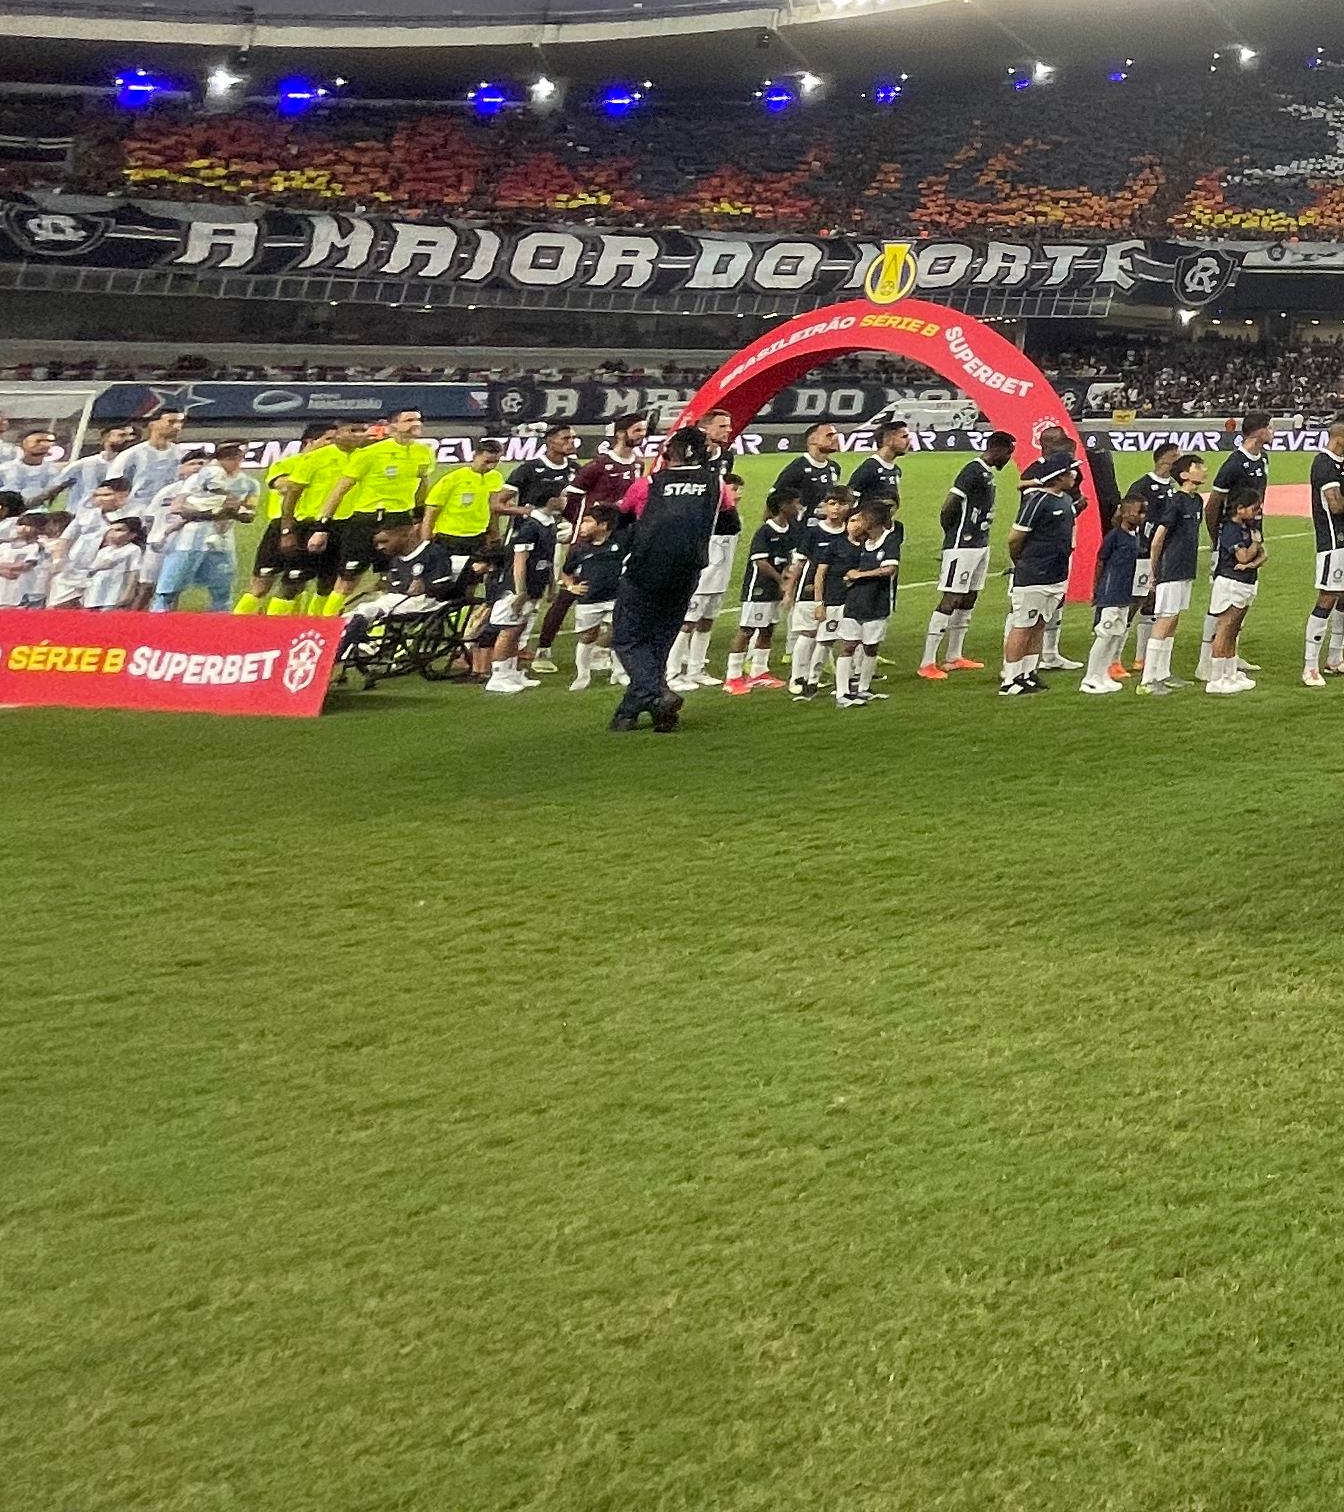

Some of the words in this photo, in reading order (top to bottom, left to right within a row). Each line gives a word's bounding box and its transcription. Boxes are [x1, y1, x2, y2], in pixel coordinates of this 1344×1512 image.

[174, 219, 259, 268] A
[300, 214, 660, 288] MAIOR
[687, 240, 824, 290] DO
[838, 239, 1146, 291] ORTE
[860, 313, 921, 332] SÉRIE
[920, 323, 941, 337] B
[945, 326, 1034, 398] SUPERBET
[1108, 431, 1221, 452] REVEMAR
[663, 482, 707, 497] STAFF
[8, 640, 102, 672] SÉRIE
[102, 648, 128, 674] B
[128, 645, 281, 685] SUPERBET
